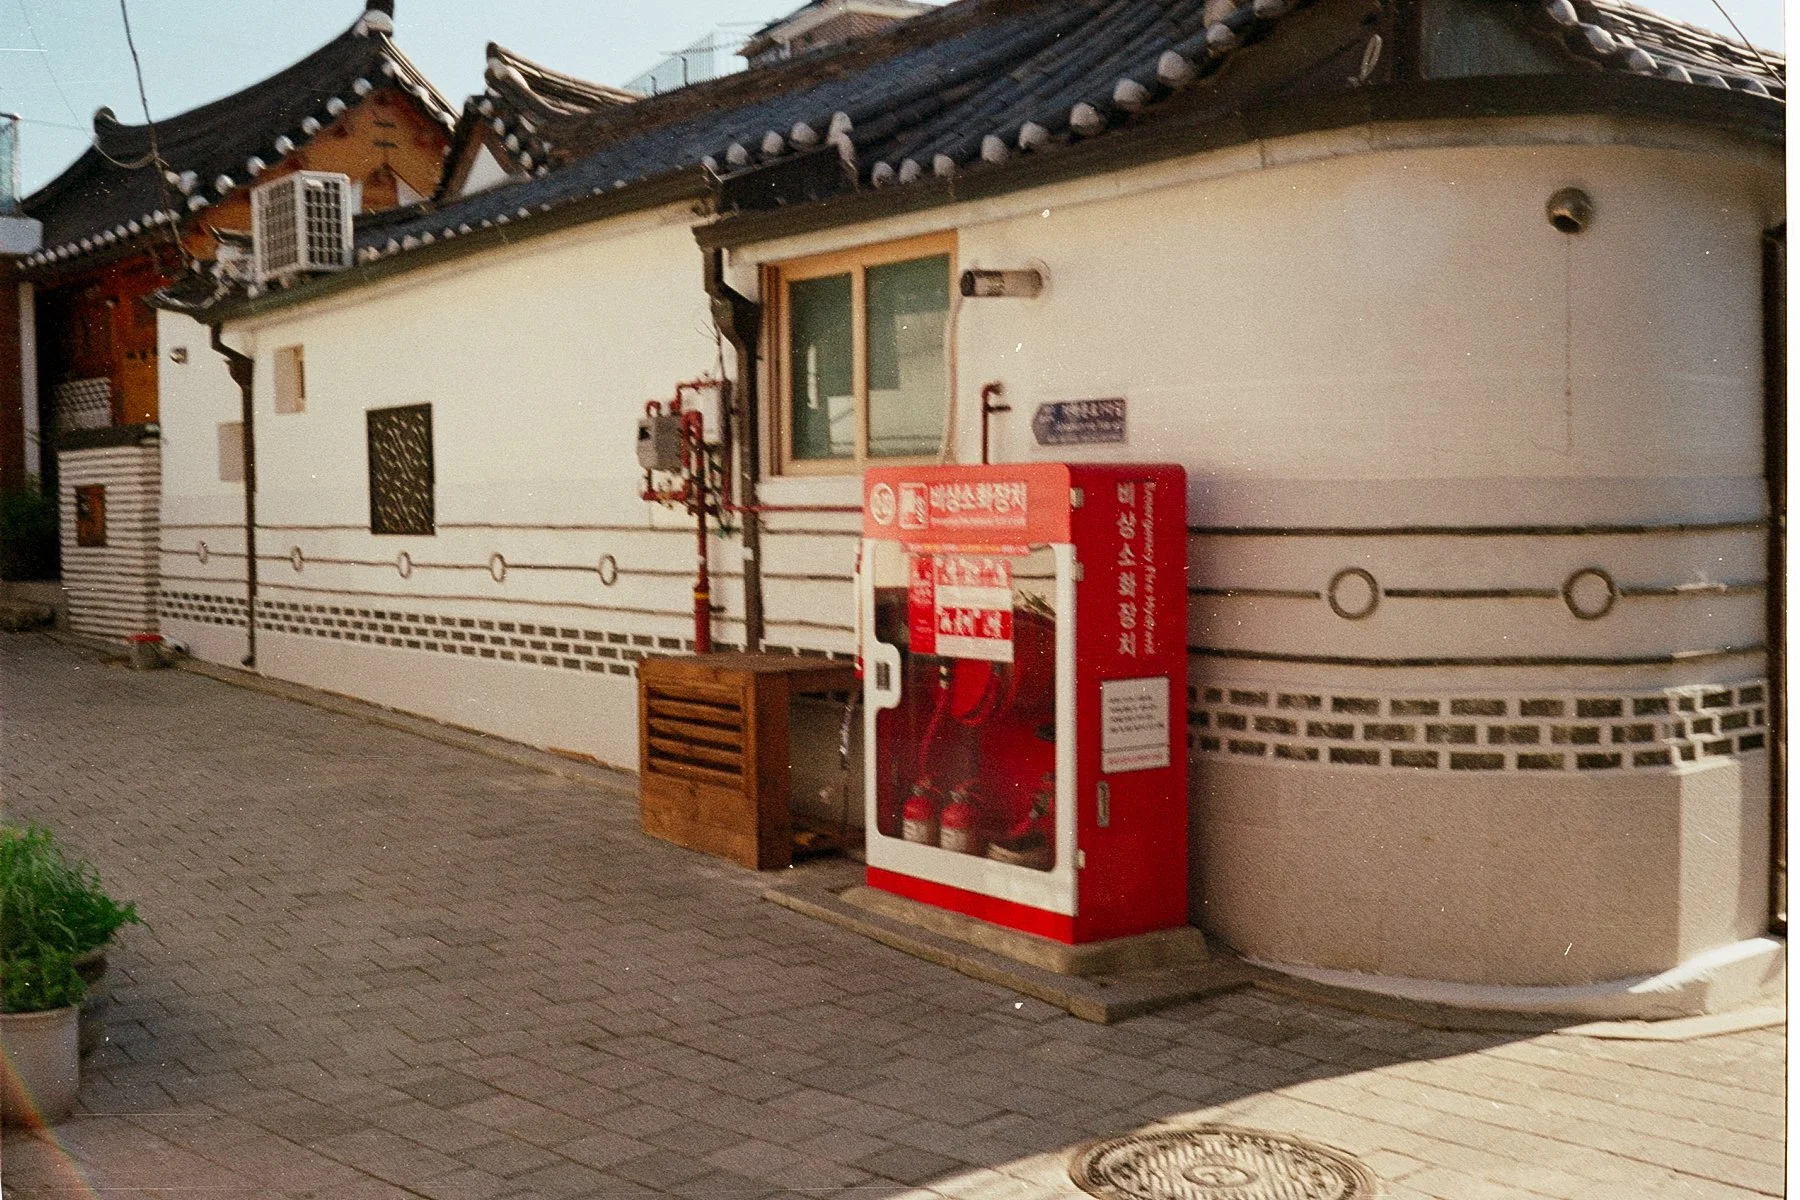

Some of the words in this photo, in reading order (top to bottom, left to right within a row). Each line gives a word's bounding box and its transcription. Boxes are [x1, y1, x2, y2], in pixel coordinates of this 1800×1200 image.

[929, 482, 1028, 513] 비상소화장치
[1142, 481, 1156, 563] Emergency
[1116, 481, 1138, 658] 비상소화장치
